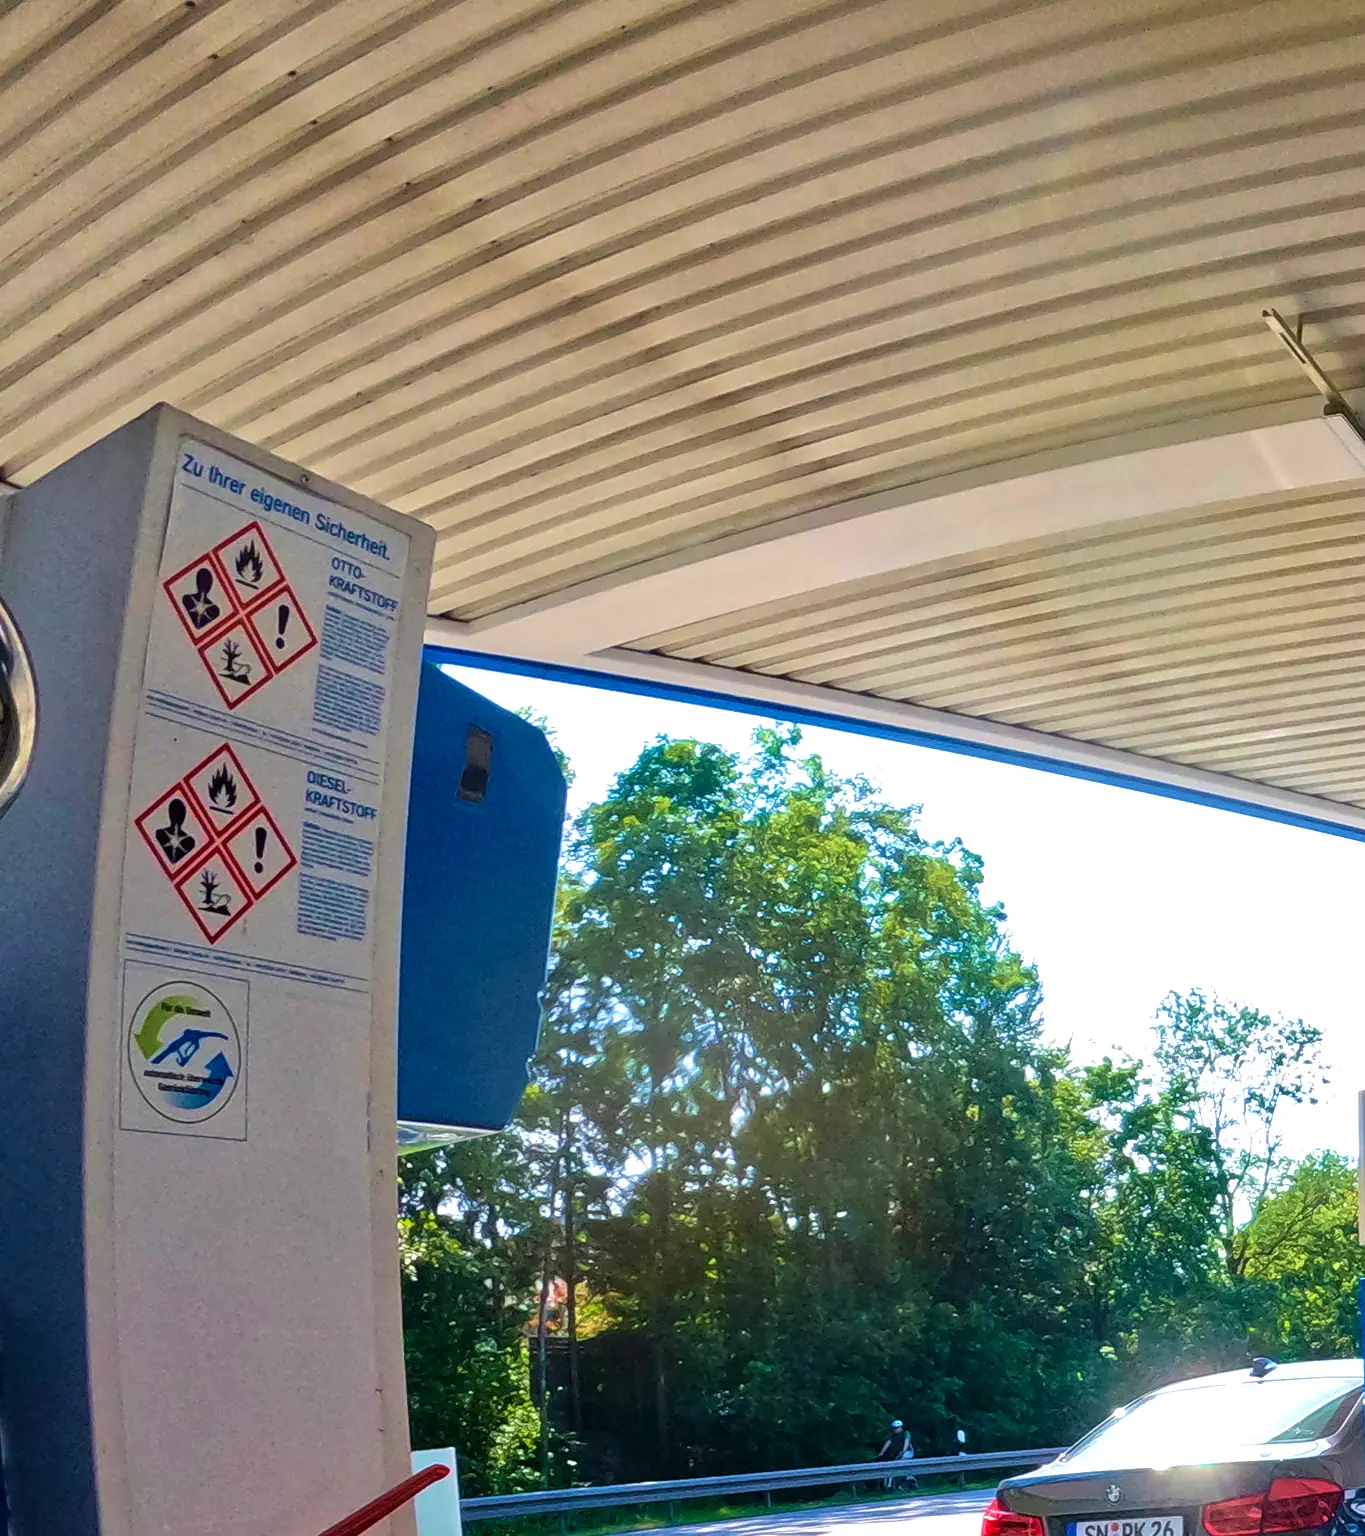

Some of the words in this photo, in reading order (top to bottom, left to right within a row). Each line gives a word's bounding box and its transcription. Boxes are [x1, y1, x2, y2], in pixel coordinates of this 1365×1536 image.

[182, 453, 203, 477] Zu
[209, 466, 246, 495] Ihrer
[250, 487, 310, 524] eigenen
[315, 512, 390, 560] Sicherheit.
[332, 557, 366, 579] OTTO-
[328, 575, 399, 612] KRAFTSTOFF
[306, 770, 351, 794] DIESEL-
[305, 788, 378, 821] KRAFTSTOFF
